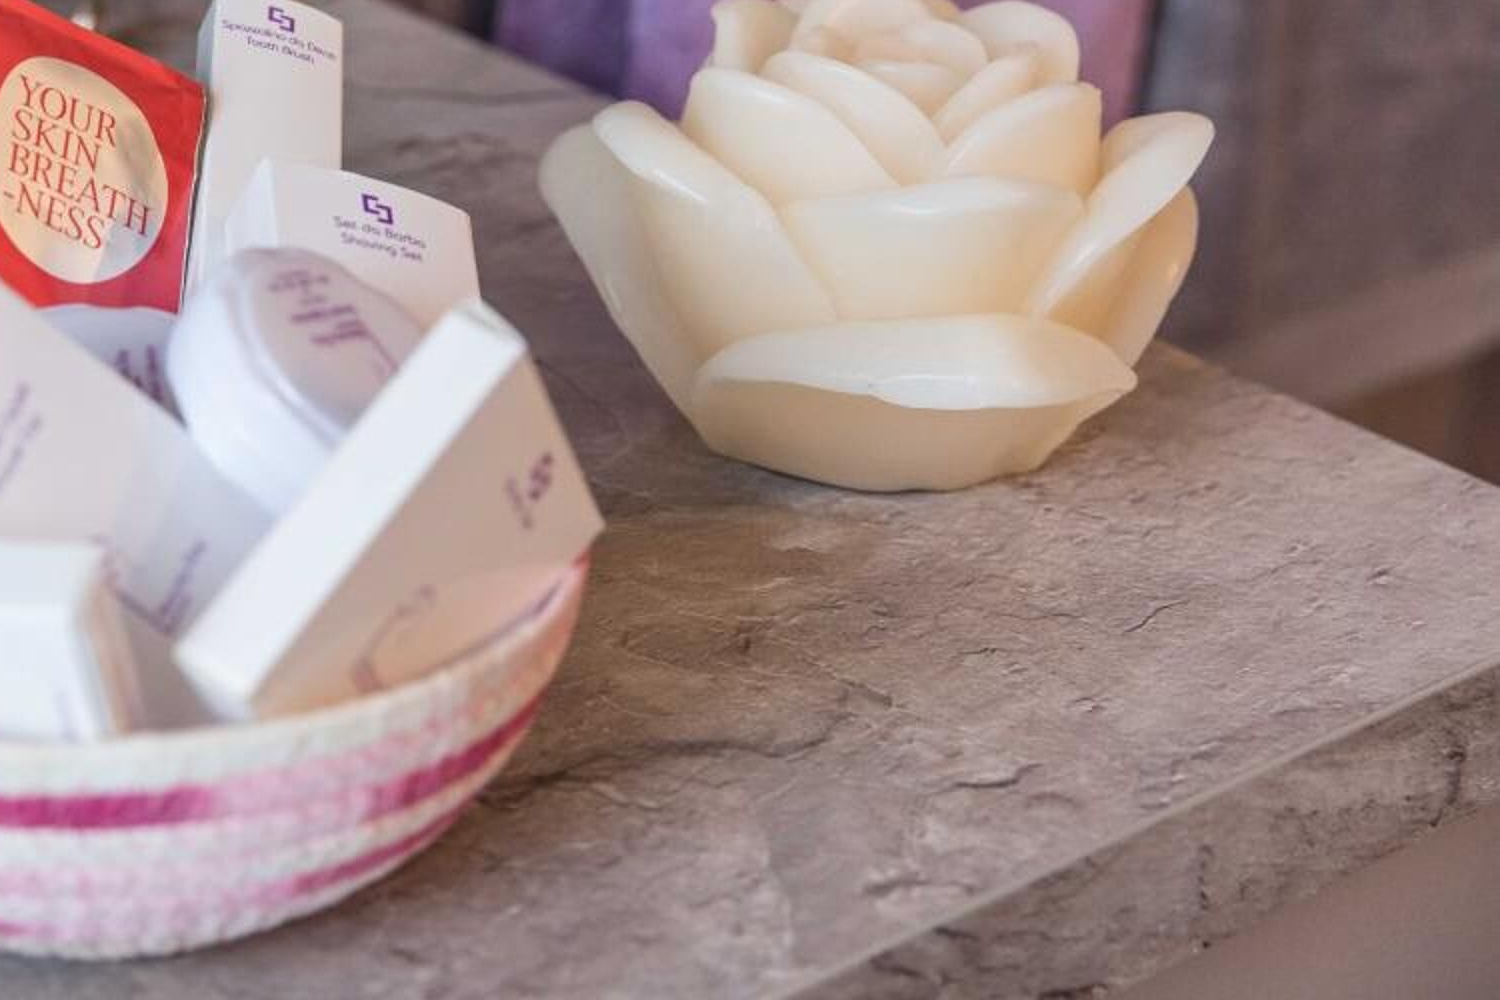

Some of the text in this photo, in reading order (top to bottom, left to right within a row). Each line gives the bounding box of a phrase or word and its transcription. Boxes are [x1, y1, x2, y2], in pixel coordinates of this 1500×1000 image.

[247, 35, 278, 52] Tooth
[12, 108, 100, 173] SKIN
[21, 74, 116, 148] YOUR
[3, 181, 106, 250] -NESS
[9, 141, 150, 237] BREATH
